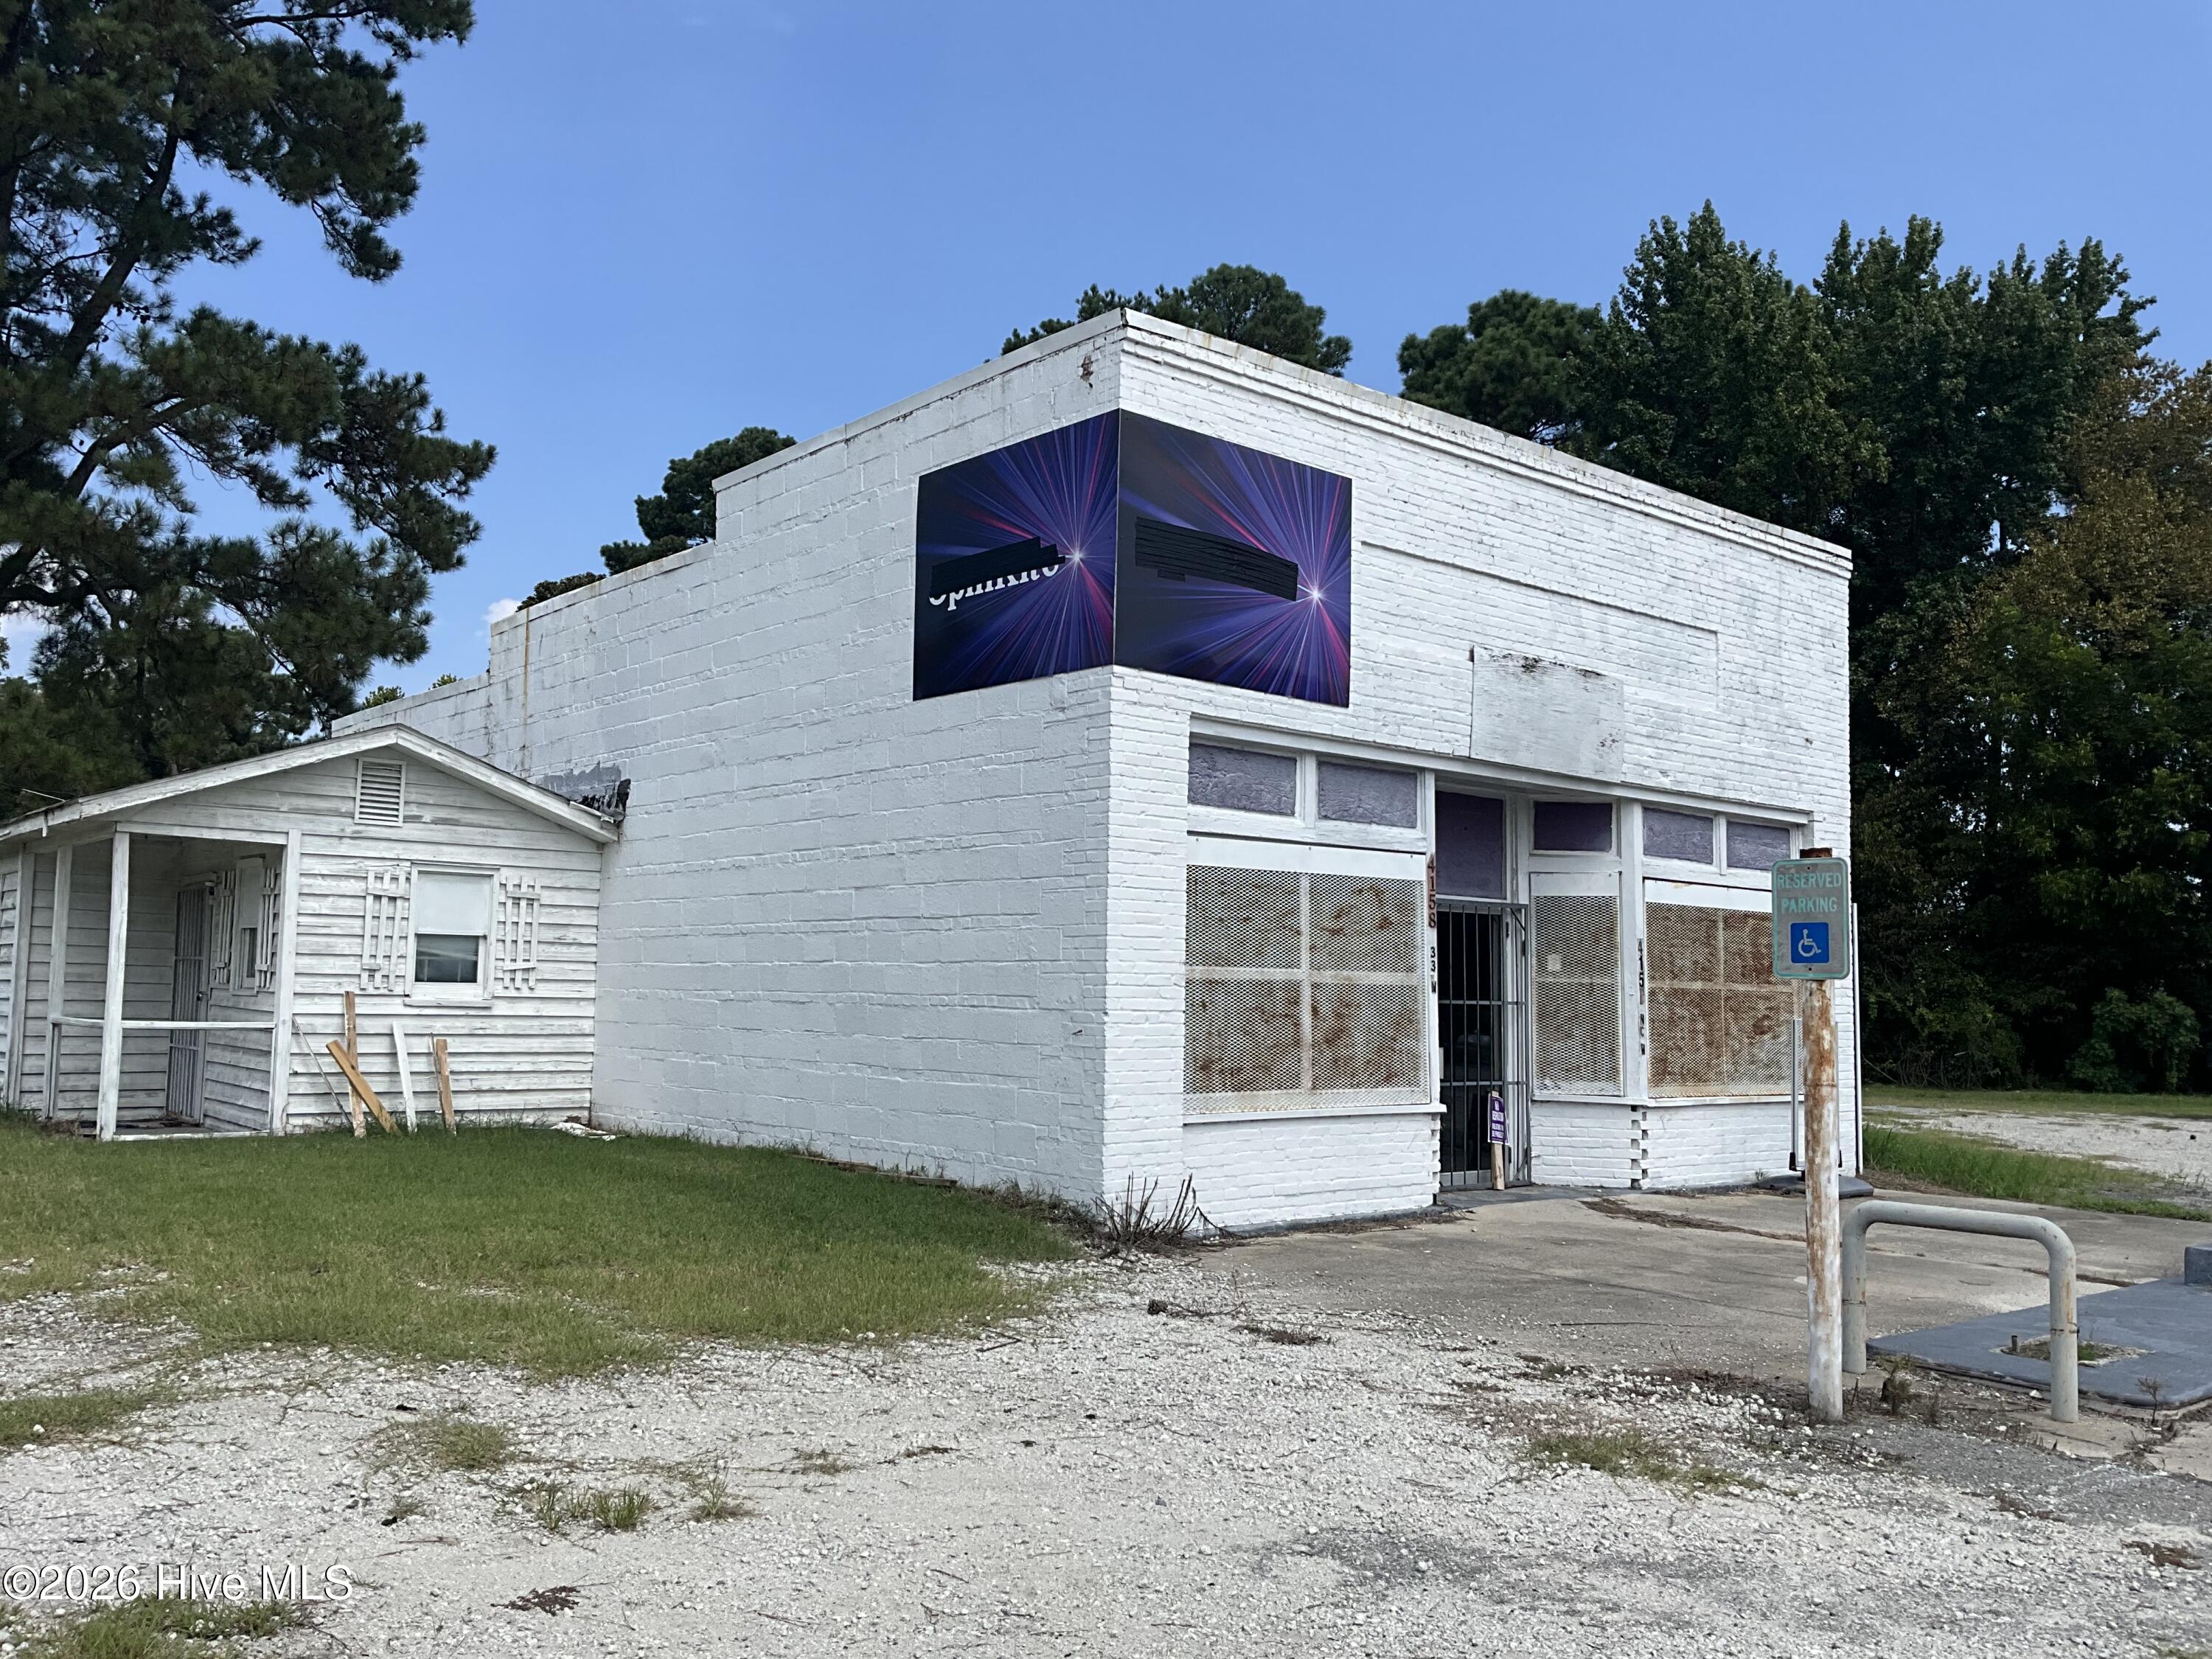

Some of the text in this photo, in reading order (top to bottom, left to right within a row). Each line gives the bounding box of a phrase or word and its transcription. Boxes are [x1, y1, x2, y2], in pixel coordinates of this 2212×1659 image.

[1776, 872, 1842, 888] RESERVED
[1427, 855, 1436, 928] 4158
[1781, 897, 1837, 914] PARKING
[1430, 947, 1436, 972] 33
